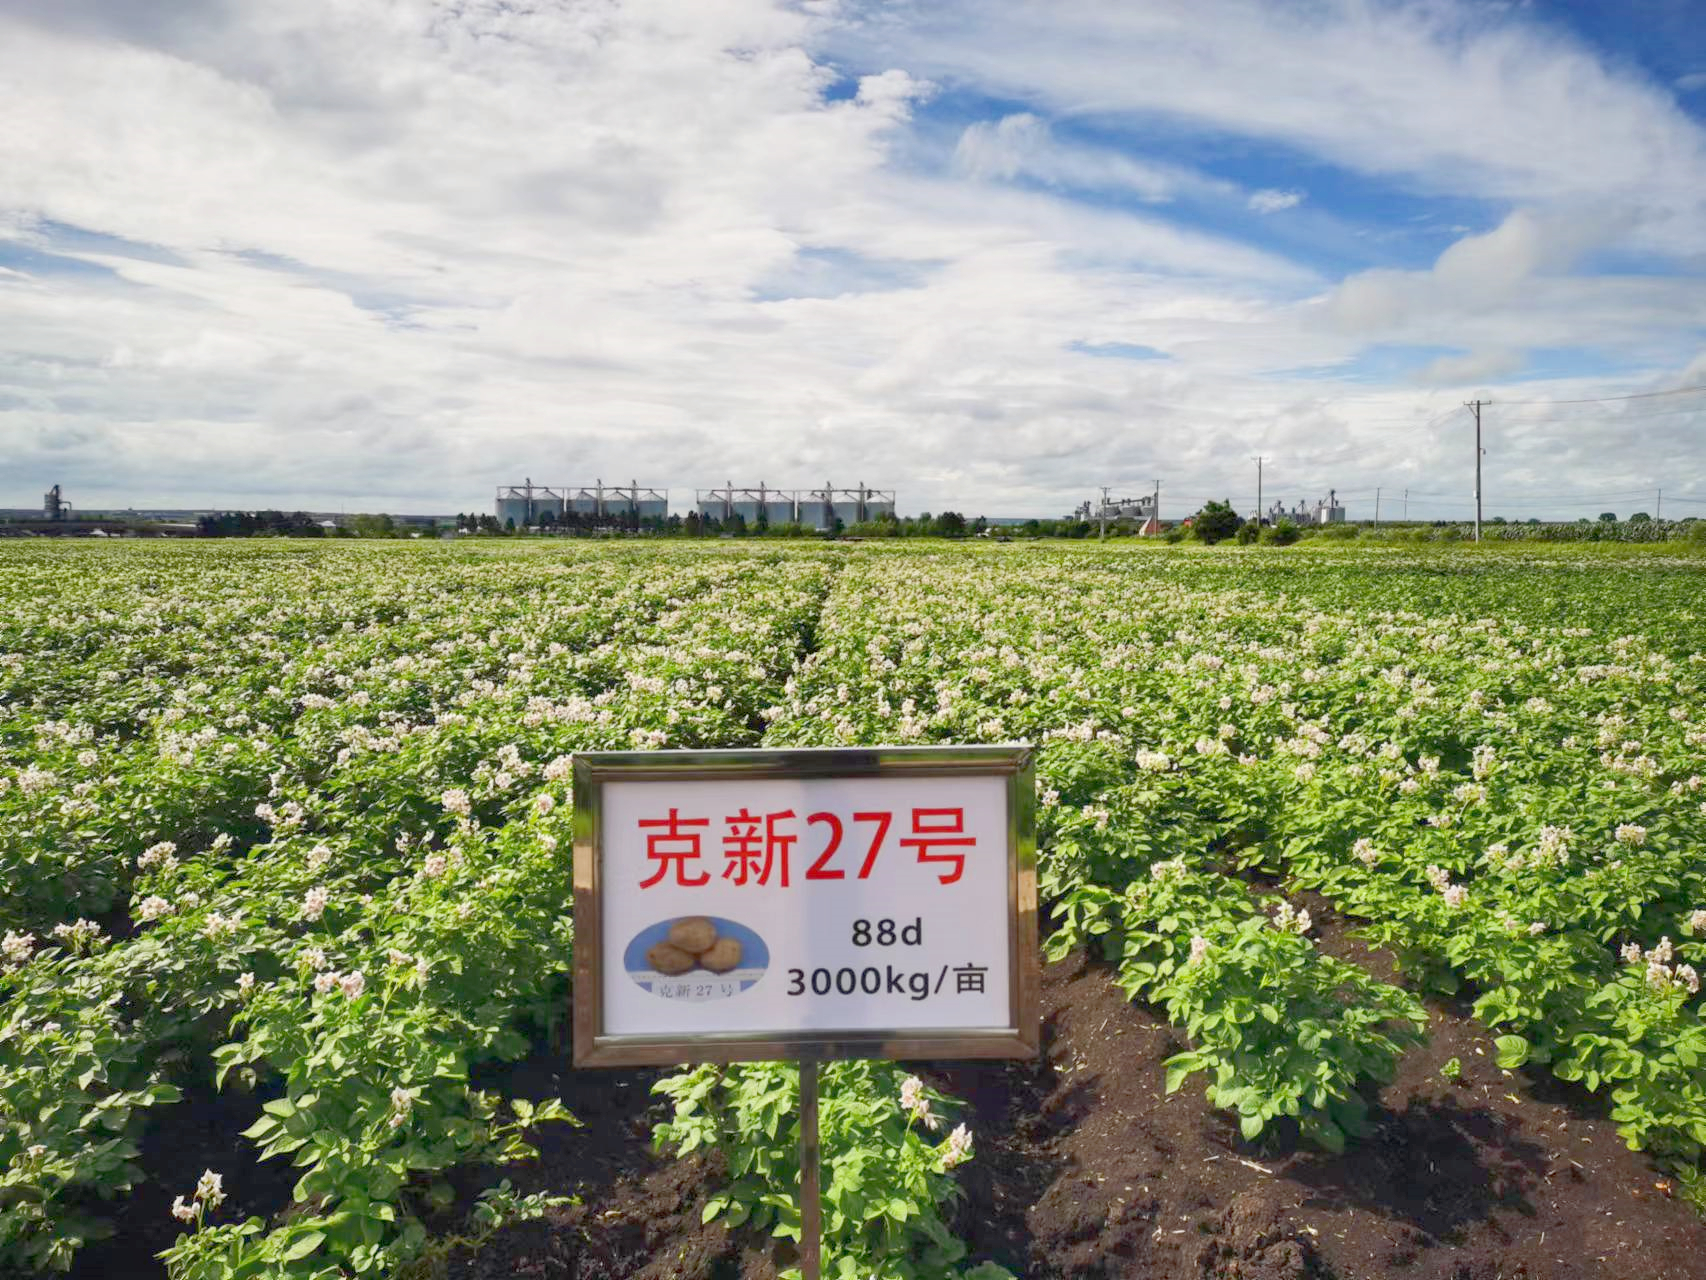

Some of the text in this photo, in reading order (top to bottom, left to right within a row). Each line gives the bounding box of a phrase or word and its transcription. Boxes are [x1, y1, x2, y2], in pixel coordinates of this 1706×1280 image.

[638, 807, 976, 890] 克新27号
[852, 917, 923, 946] 88d
[786, 962, 989, 1000] 3000kg/亩
